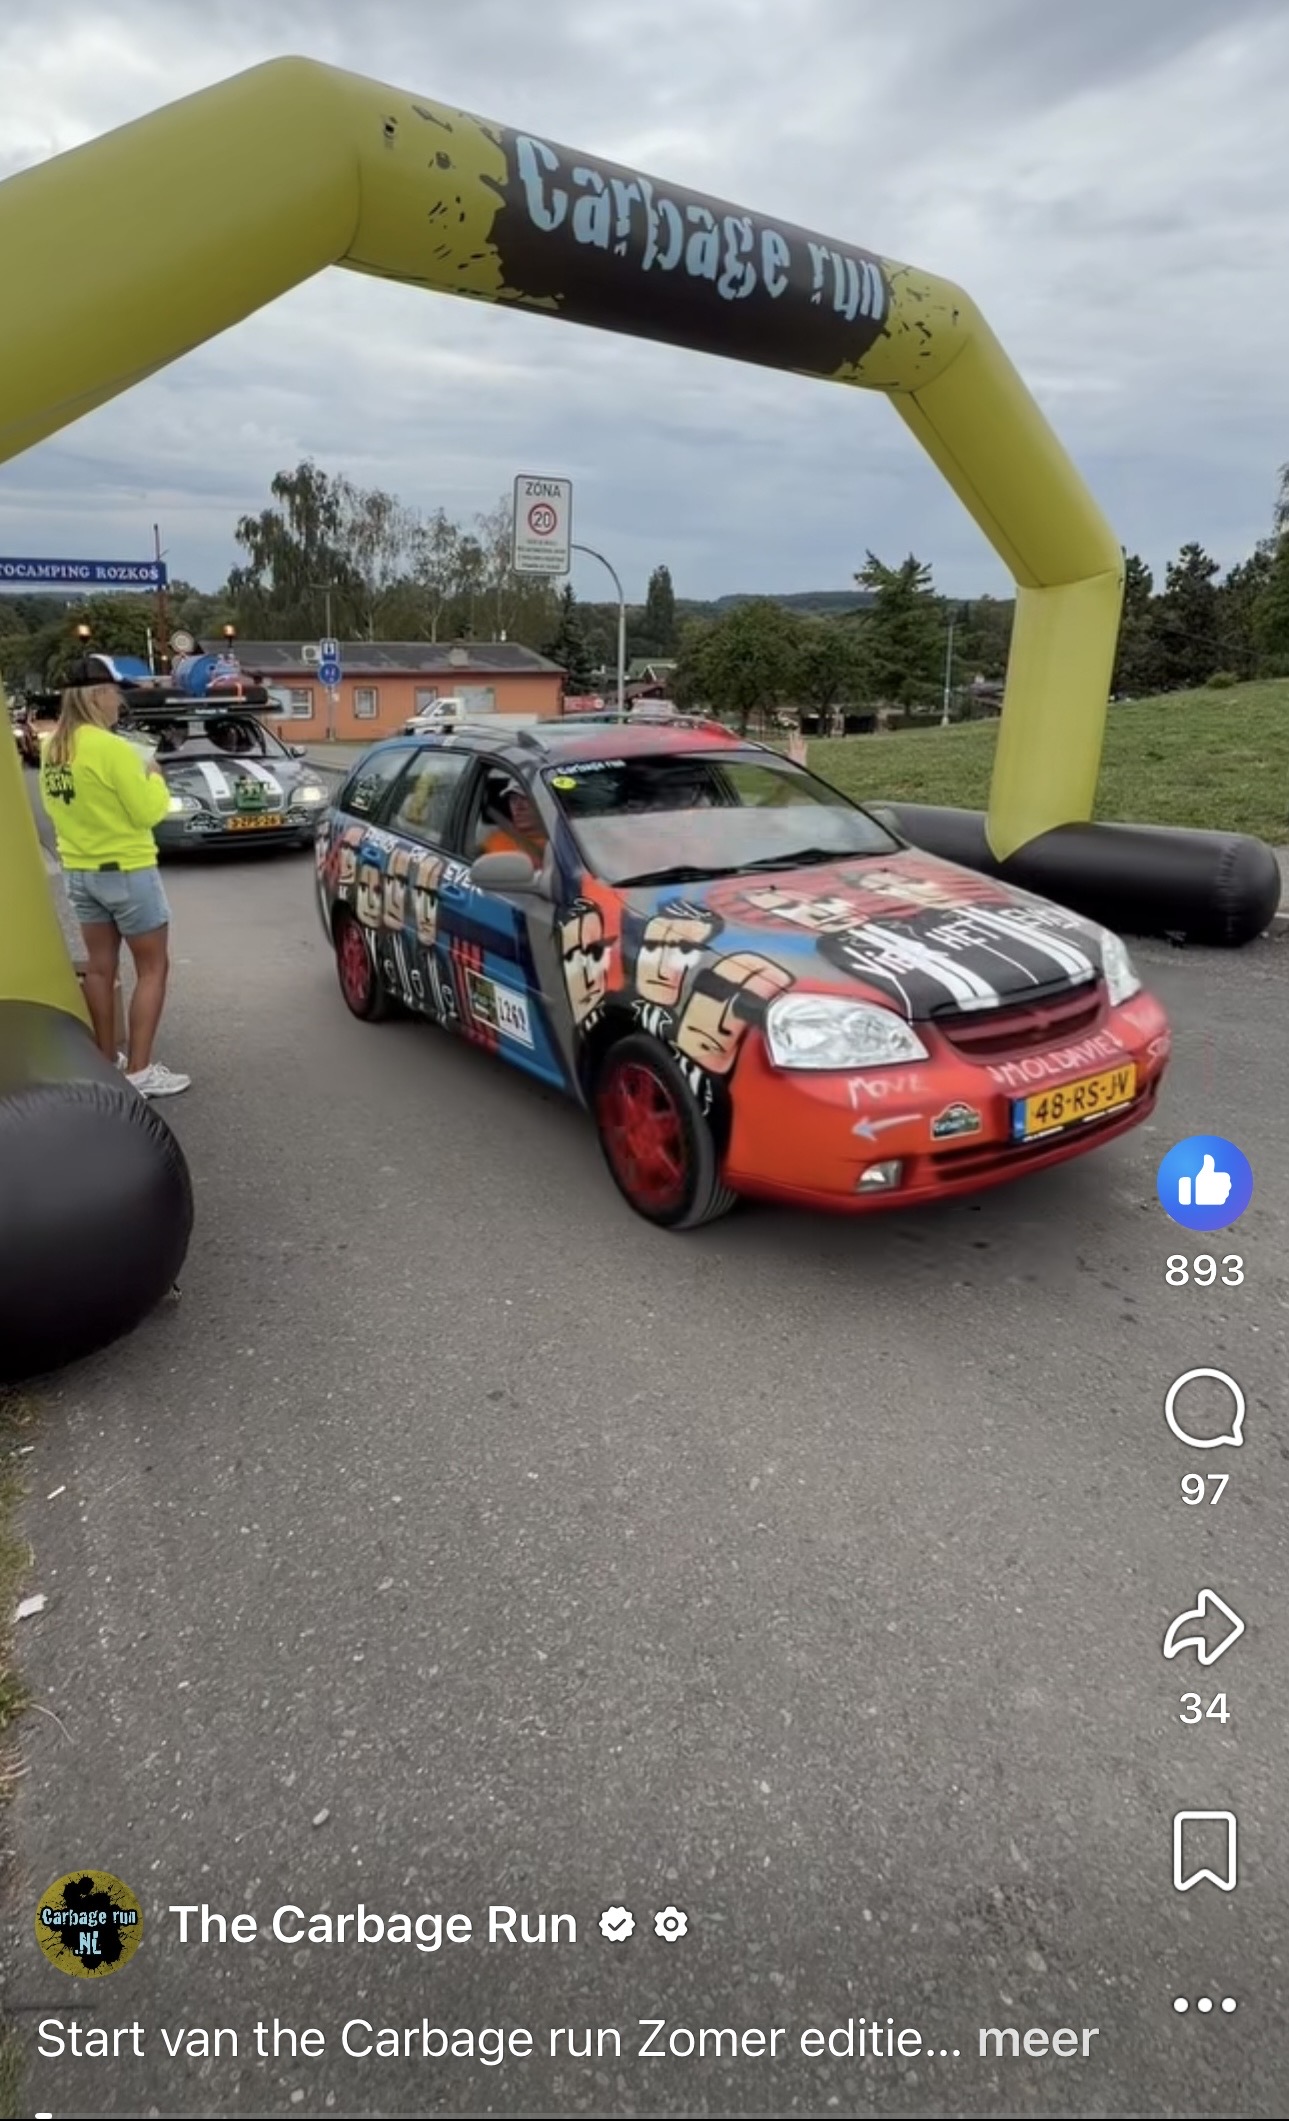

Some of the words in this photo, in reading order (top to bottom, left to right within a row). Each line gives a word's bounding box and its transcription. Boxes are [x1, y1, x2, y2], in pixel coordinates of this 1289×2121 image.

[514, 135, 792, 300] Carbage
[808, 241, 885, 322] run
[532, 510, 552, 528] 20
[924, 917, 1000, 952] HET
[1034, 1070, 1130, 1124] 48-RS-JV
